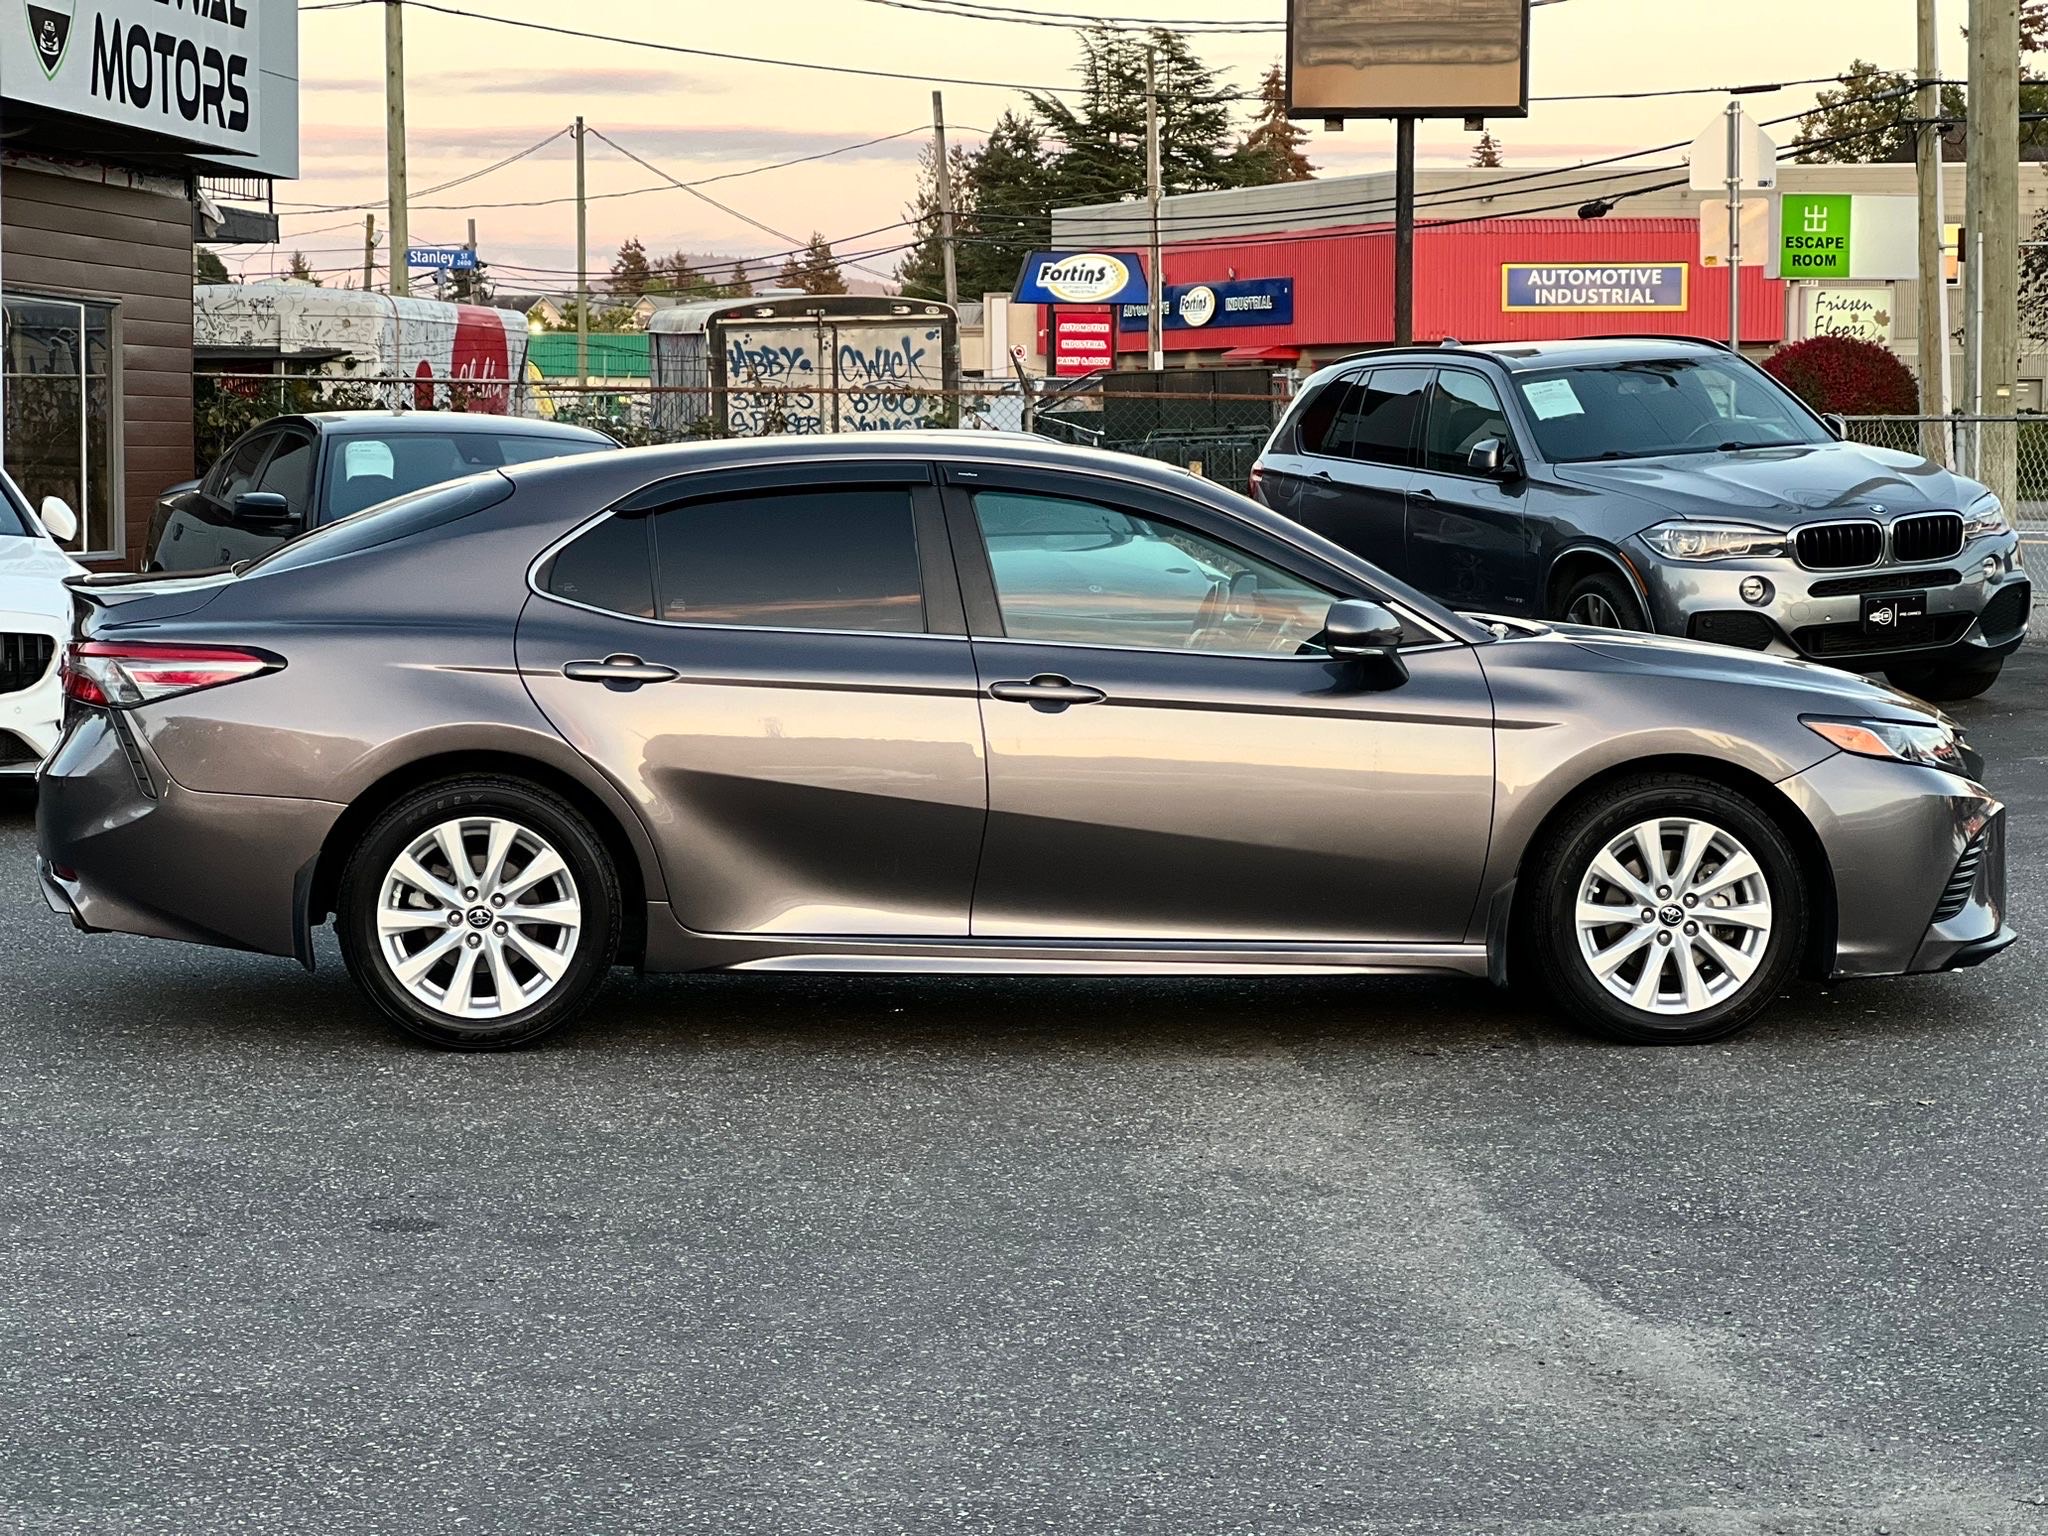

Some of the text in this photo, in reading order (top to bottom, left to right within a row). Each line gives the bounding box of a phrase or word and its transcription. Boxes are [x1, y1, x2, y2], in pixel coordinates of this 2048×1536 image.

[91, 12, 249, 132] MOTORS
[1785, 236, 1844, 249] ESCAPE
[410, 251, 454, 266] Stanley
[1792, 254, 1836, 267] ROOM
[1528, 269, 1662, 285] AUTOMOTIVE
[1225, 295, 1272, 311] INDUSTRIAL
[1535, 288, 1655, 304] INDUSTRIAL
[1816, 292, 1873, 313] Friesen
[1060, 323, 1109, 332] AUTOMOTIVE
[1815, 316, 1865, 336] Floors
[1062, 340, 1107, 349] INDUSTRIAL
[1057, 357, 1080, 365] PAINT
[1088, 357, 1110, 365] BODY
